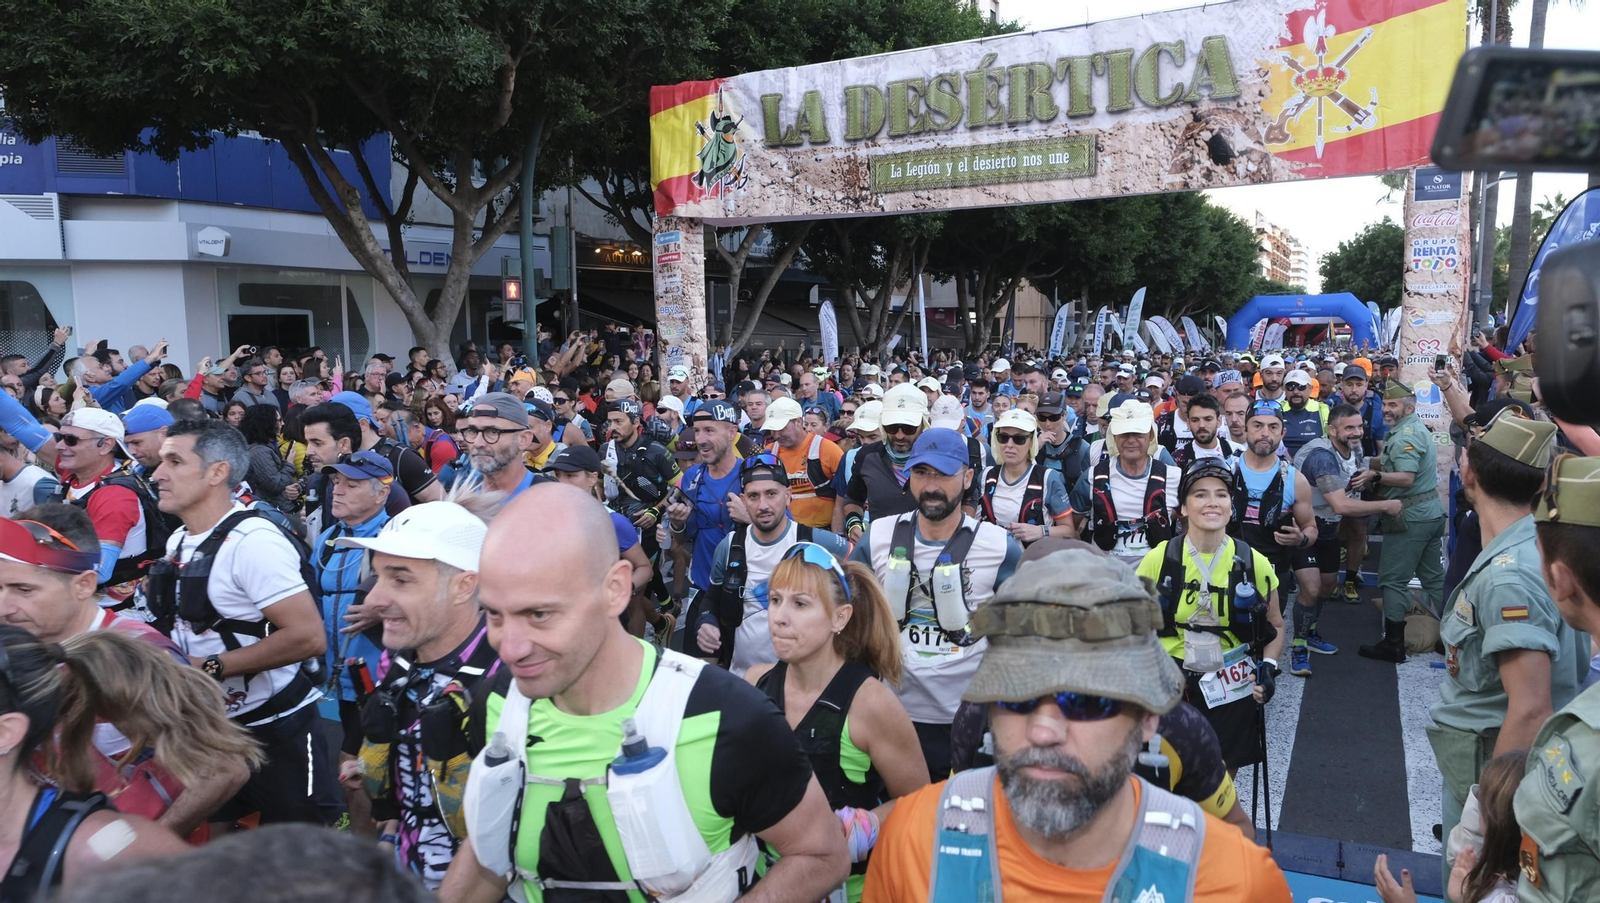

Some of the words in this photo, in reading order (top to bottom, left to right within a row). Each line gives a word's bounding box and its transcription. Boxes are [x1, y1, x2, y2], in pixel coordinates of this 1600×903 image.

[760, 89, 831, 147] LA
[843, 35, 1242, 142] DESÉRTICA
[890, 163, 903, 179] La
[906, 158, 940, 180] Legión
[945, 163, 953, 177] y
[958, 157, 968, 172] el
[973, 154, 1017, 171] desierto
[1022, 155, 1042, 167] nos
[1048, 151, 1071, 165] une
[1414, 238, 1456, 246] GRUPO
[1413, 246, 1457, 256] RENTA
[1413, 257, 1457, 270] TODO
[660, 305, 680, 314] BBVA
